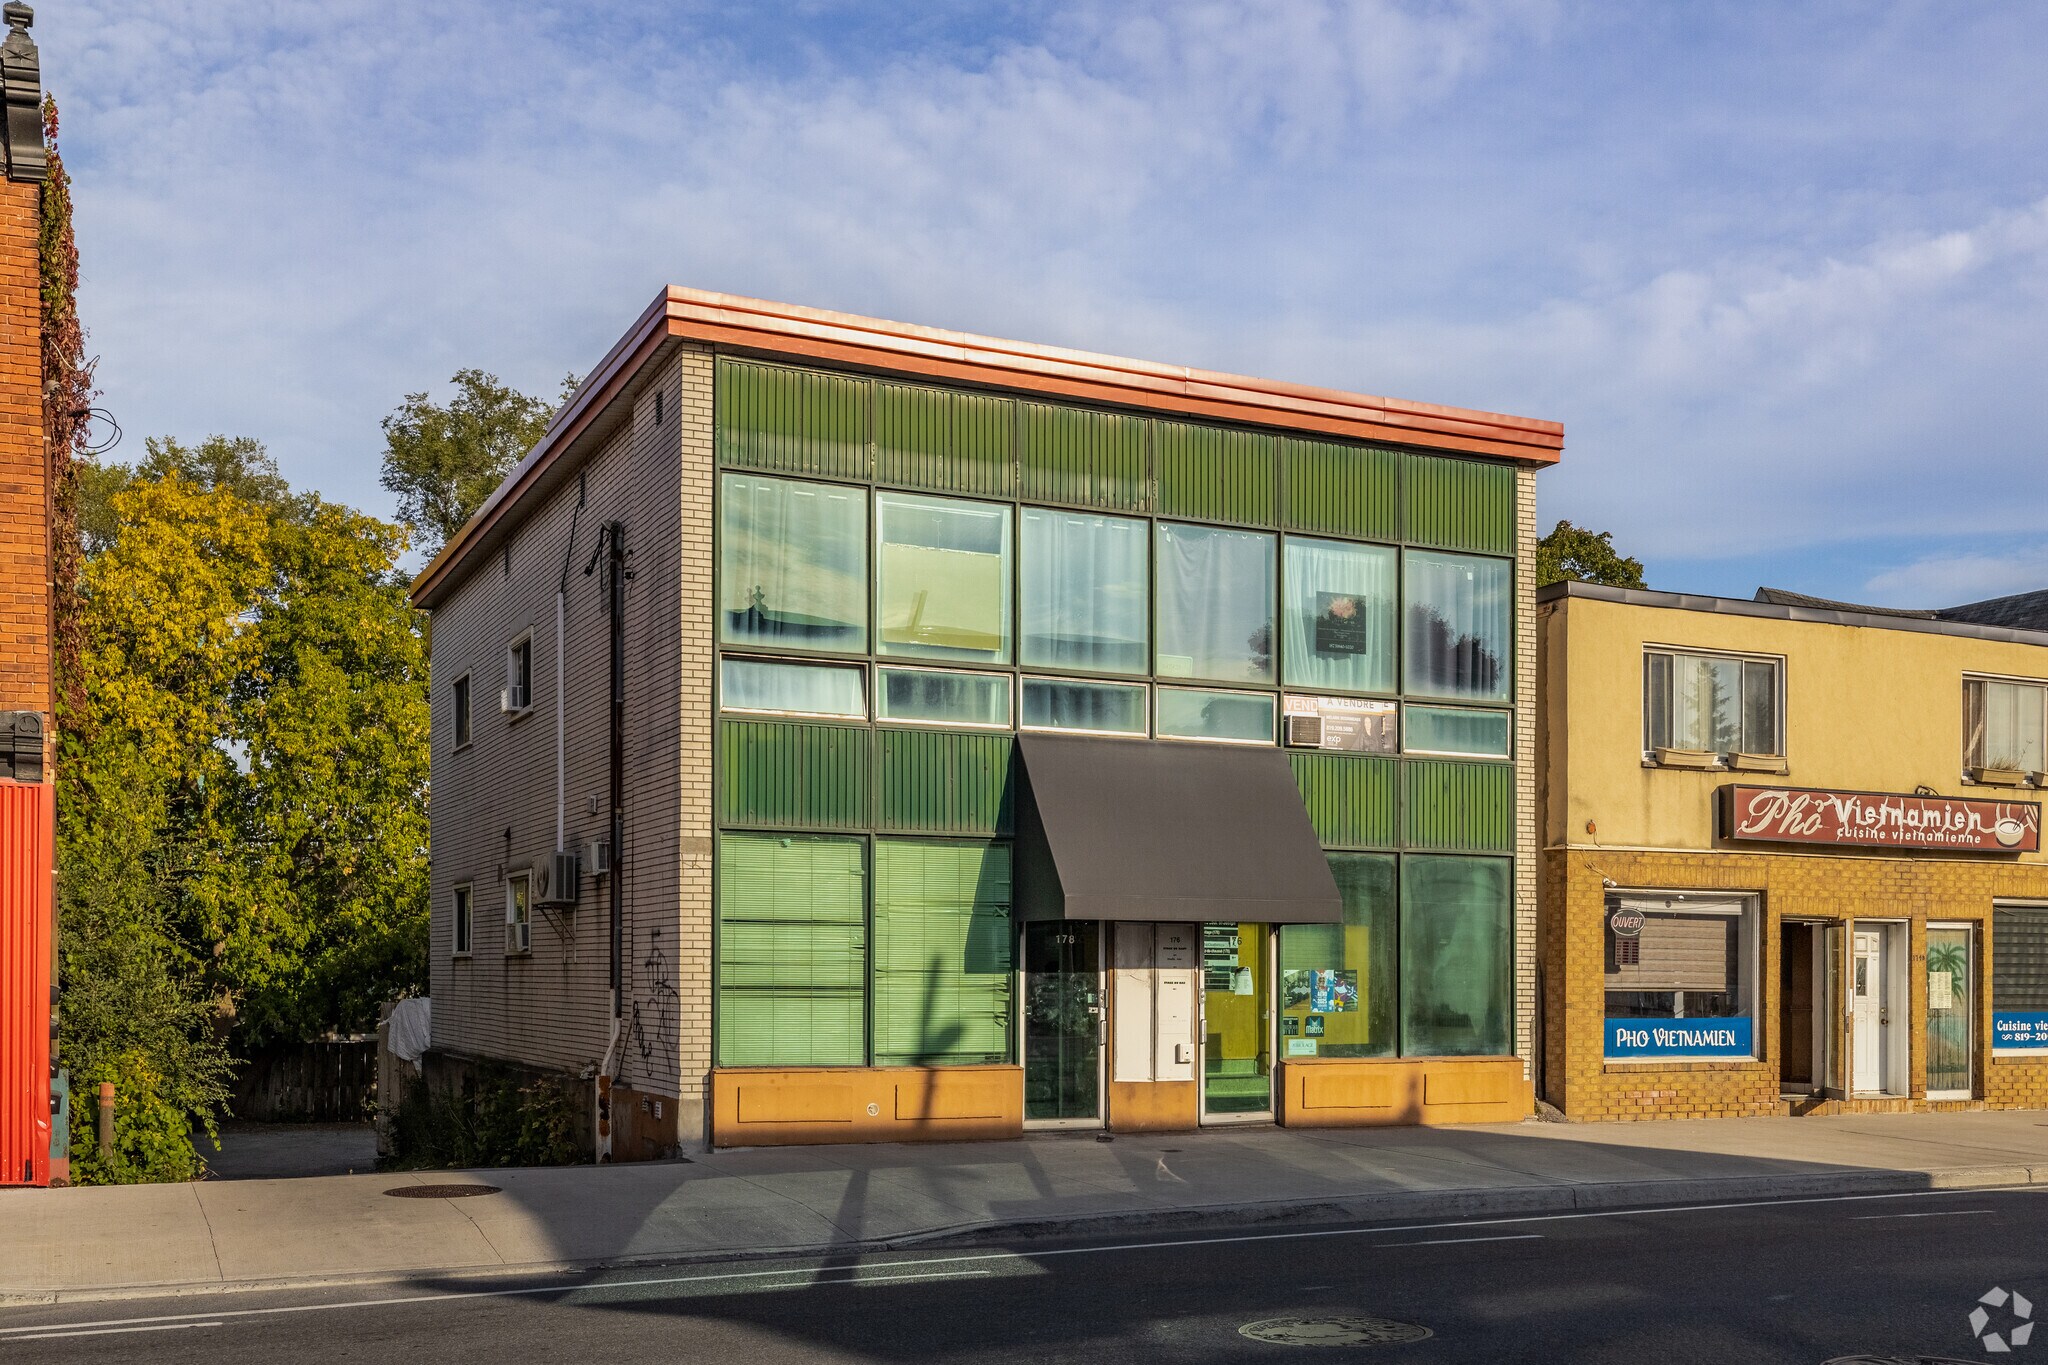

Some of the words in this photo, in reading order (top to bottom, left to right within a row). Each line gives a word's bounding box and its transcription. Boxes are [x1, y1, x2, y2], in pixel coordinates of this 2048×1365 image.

[1337, 699, 1374, 709] VENDRE
[1326, 735, 1342, 744] exp
[1833, 794, 1981, 829] Vietnamien
[1836, 826, 1886, 840] cuisine
[1892, 828, 1981, 844] vietnamienne
[1612, 916, 1643, 929] OUVERT
[1056, 934, 1075, 944] 178
[1170, 936, 1181, 944] 176
[1305, 1025, 1324, 1034] Matrix
[1997, 1019, 2032, 1031] Cuisine
[1616, 1027, 1650, 1048] PHO
[1652, 1027, 1736, 1047] VIETNAMIEN
